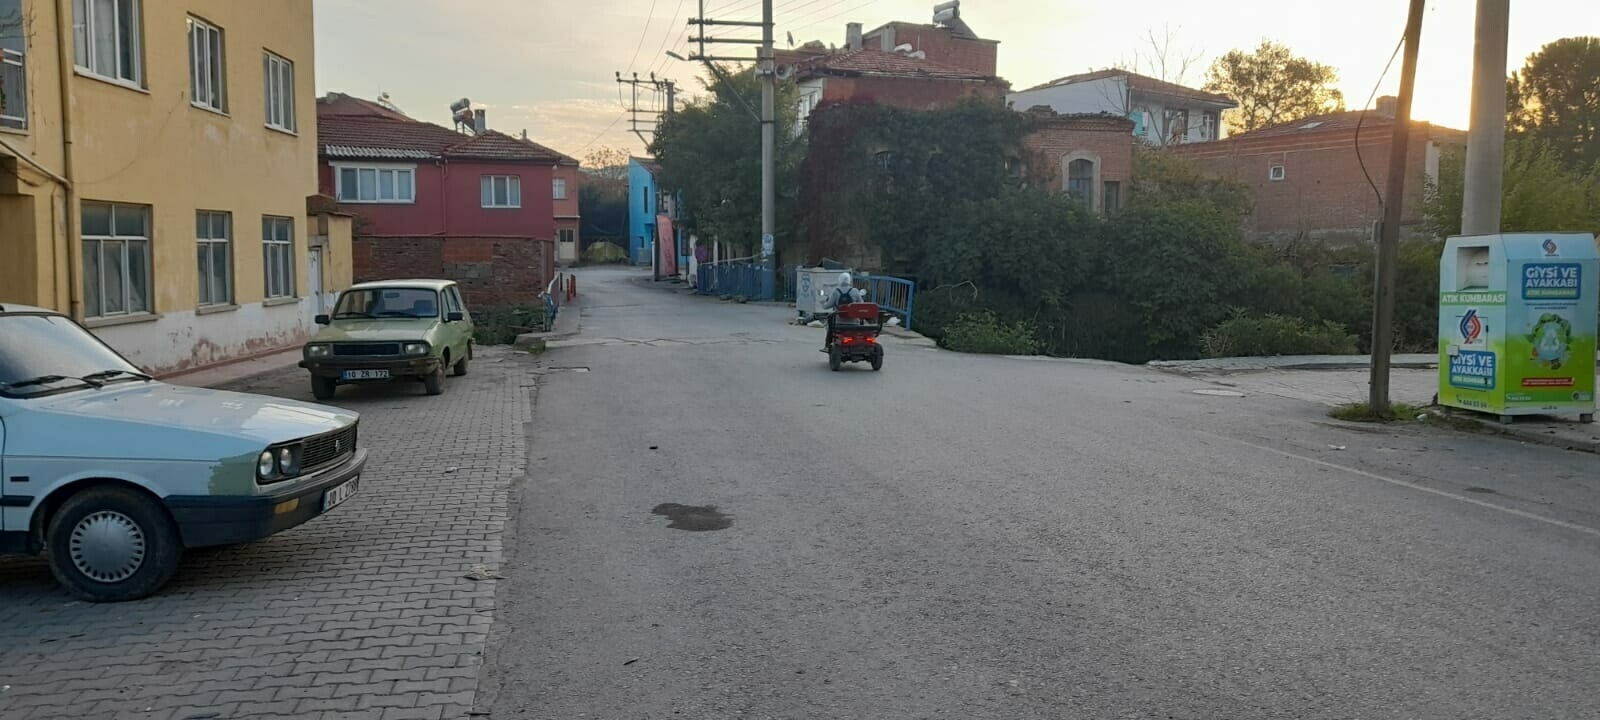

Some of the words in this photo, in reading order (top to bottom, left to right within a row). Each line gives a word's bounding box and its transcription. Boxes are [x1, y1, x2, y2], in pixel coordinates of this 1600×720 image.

[1526, 266, 1558, 278] GİYSİ
[1560, 267, 1577, 278] VE
[1526, 278, 1577, 287] AYAKKABI
[1442, 294, 1459, 303] ATIK
[1460, 294, 1505, 303] KUMBARASI
[1478, 355, 1493, 367] VE
